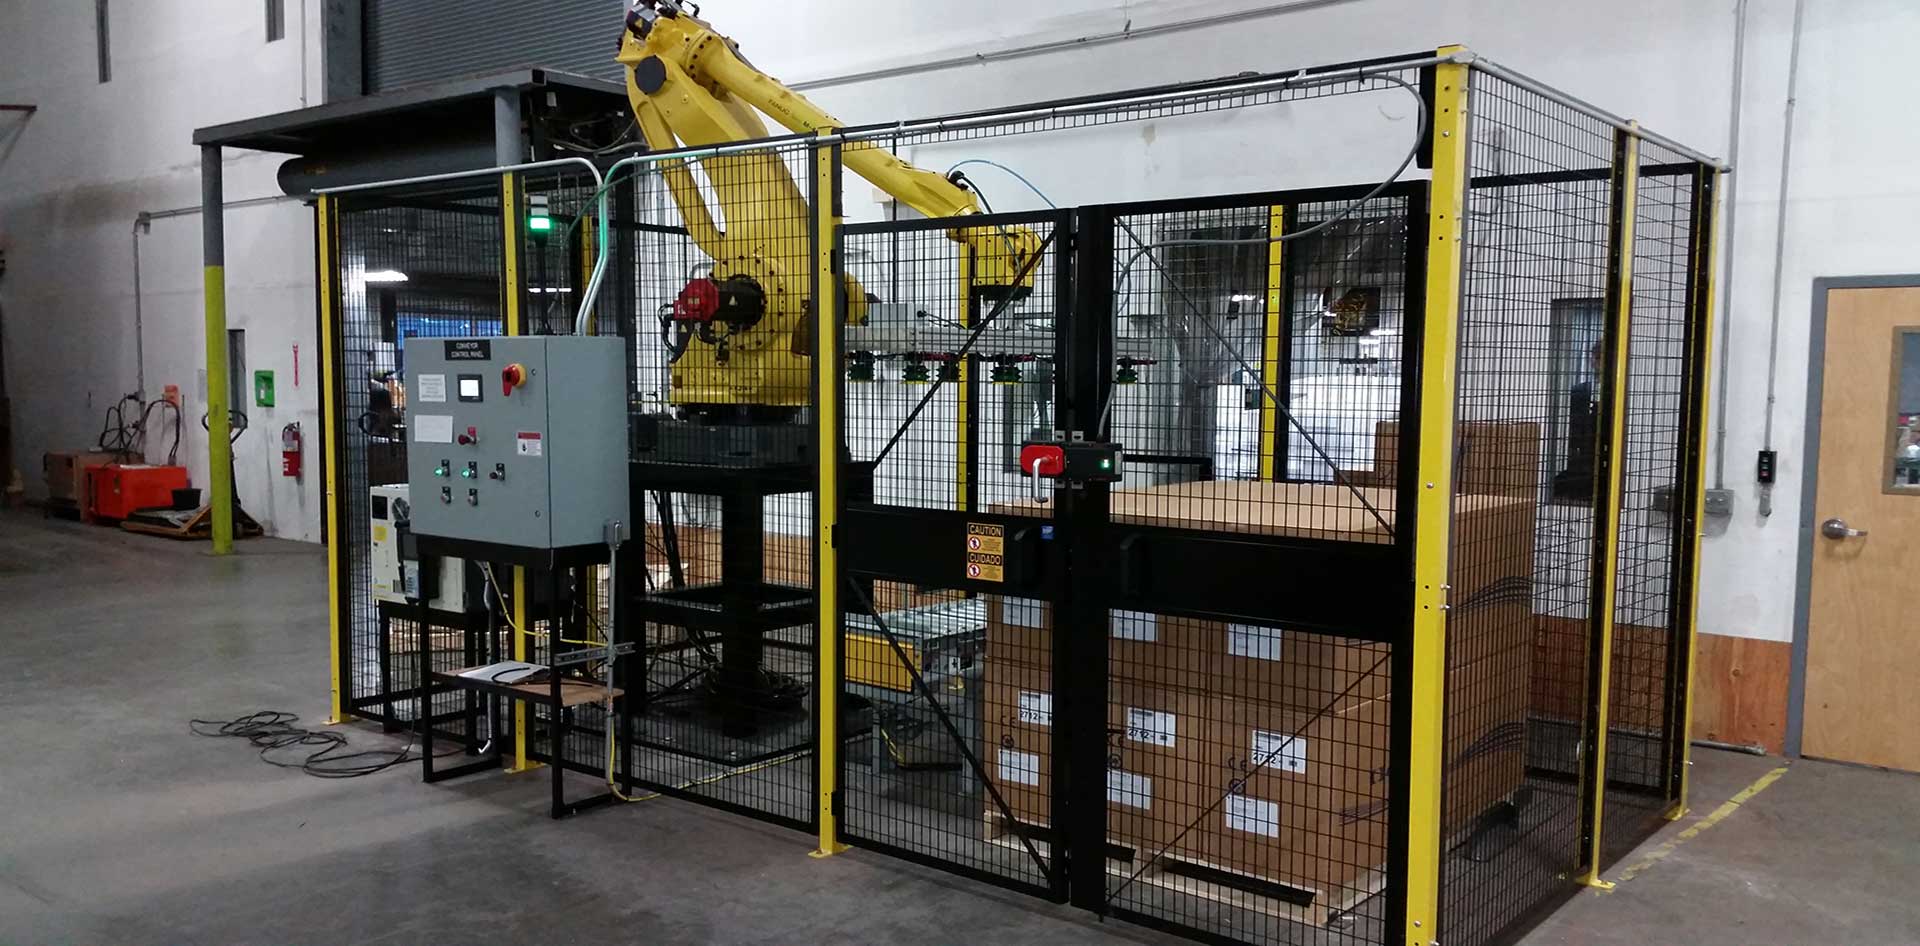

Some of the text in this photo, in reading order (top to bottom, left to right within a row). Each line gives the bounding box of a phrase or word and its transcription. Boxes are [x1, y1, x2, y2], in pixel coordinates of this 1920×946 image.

[768, 99, 790, 115] FANUC
[969, 525, 1002, 537] CAUTION
[969, 553, 1001, 565] CUIDADO
